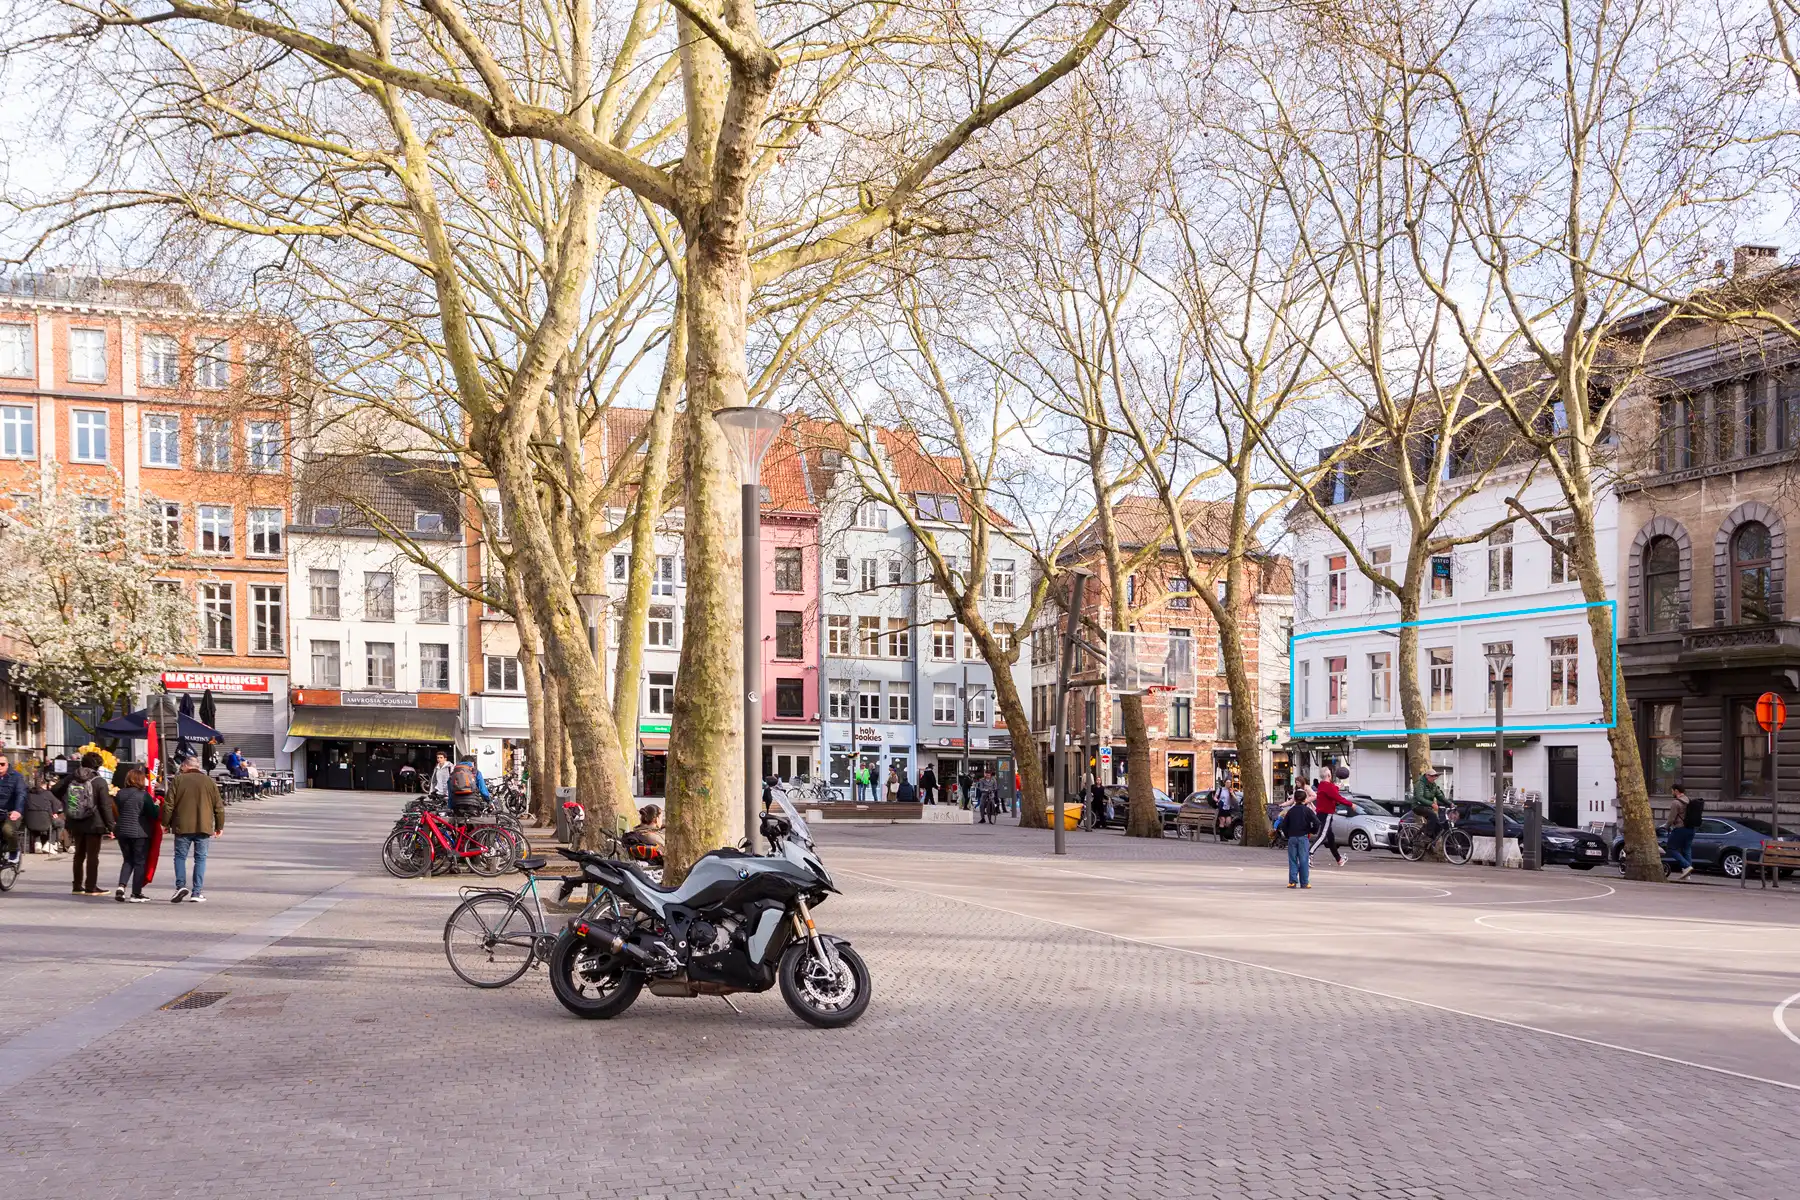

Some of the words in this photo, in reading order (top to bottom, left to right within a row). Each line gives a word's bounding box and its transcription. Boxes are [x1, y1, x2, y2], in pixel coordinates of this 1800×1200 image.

[165, 673, 265, 685] NACHTWINKEL
[859, 727, 876, 735] holy
[855, 734, 882, 742] cookies
